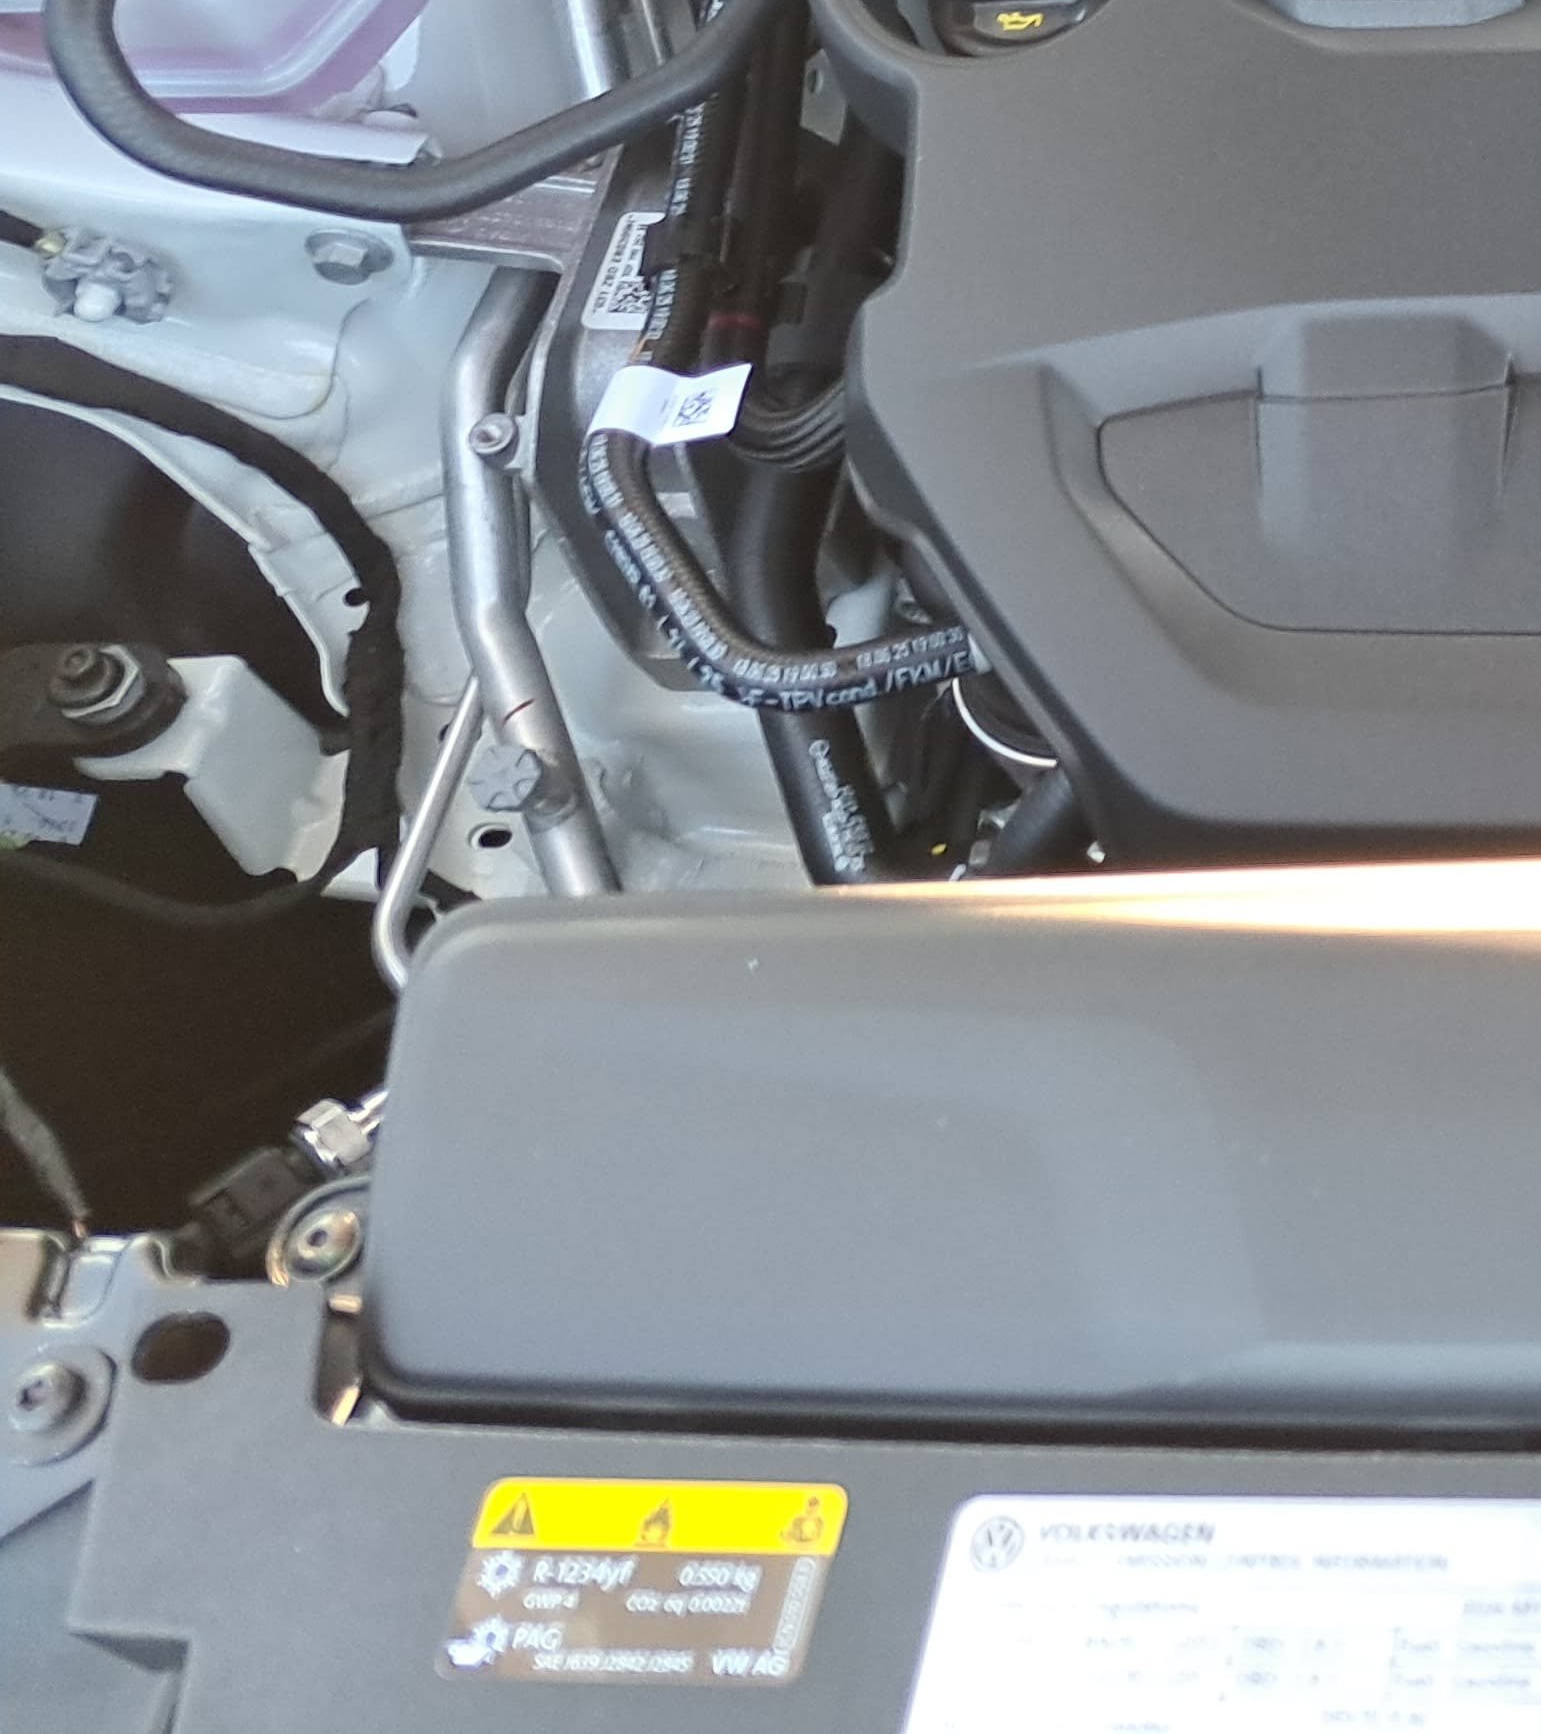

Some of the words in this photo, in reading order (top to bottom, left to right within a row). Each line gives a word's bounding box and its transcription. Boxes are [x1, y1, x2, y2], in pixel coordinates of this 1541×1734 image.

[511, 1625, 561, 1651] PAG
[711, 1651, 748, 1675] VW
[751, 1653, 791, 1677] AG
